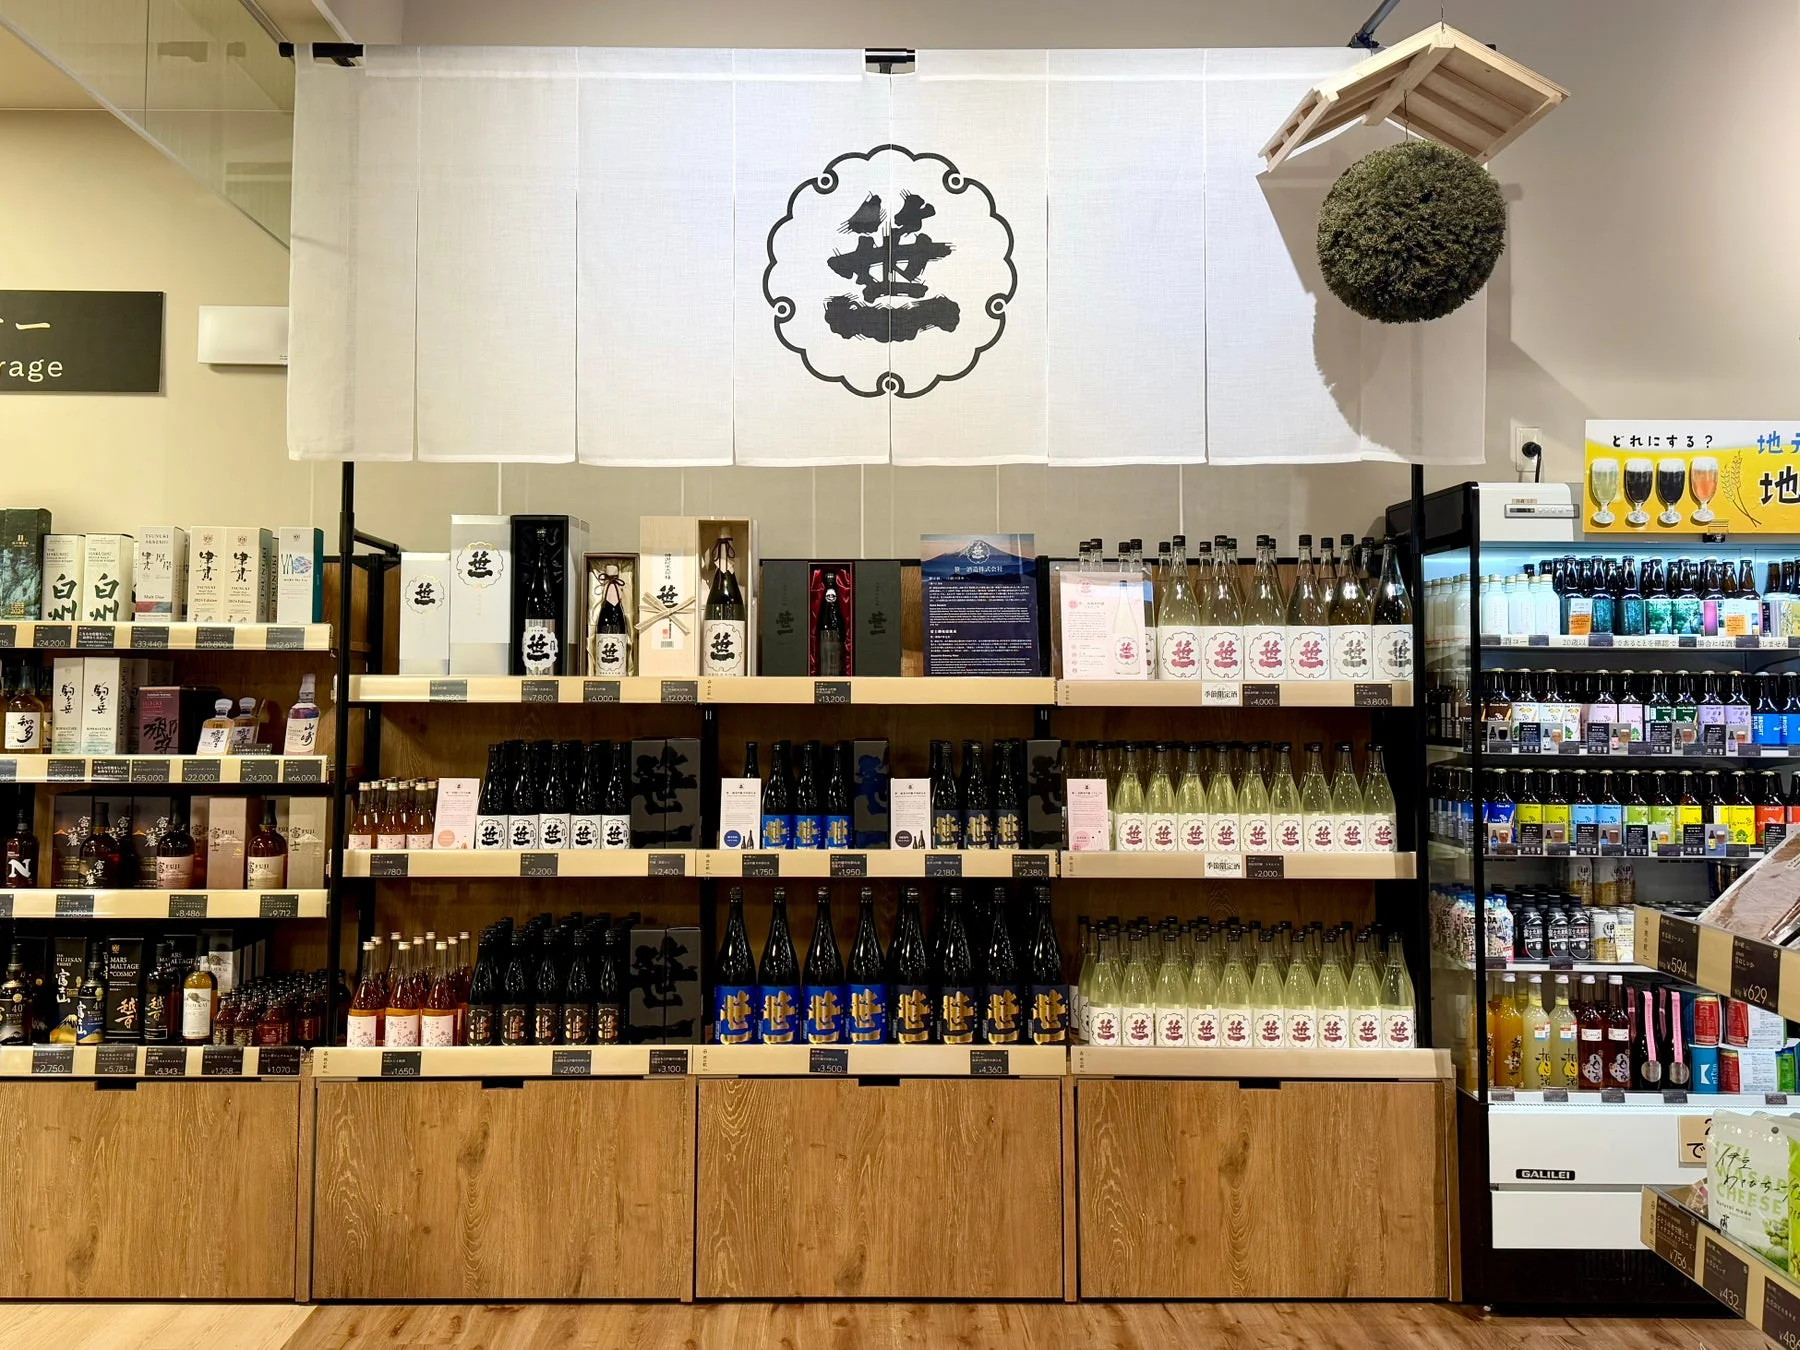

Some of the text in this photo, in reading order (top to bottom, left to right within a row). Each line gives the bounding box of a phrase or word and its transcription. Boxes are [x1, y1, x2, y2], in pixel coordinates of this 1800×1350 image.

[1612, 434, 1713, 448] どれにする？
[48, 573, 77, 621] 白州
[90, 573, 119, 621] 白州
[1666, 957, 1688, 976] ¥594
[1743, 984, 1767, 1004] ¥629
[1521, 1170, 1570, 1179] GALILEI
[1669, 1249, 1687, 1269] ¥756
[1719, 1287, 1739, 1310] ¥432
